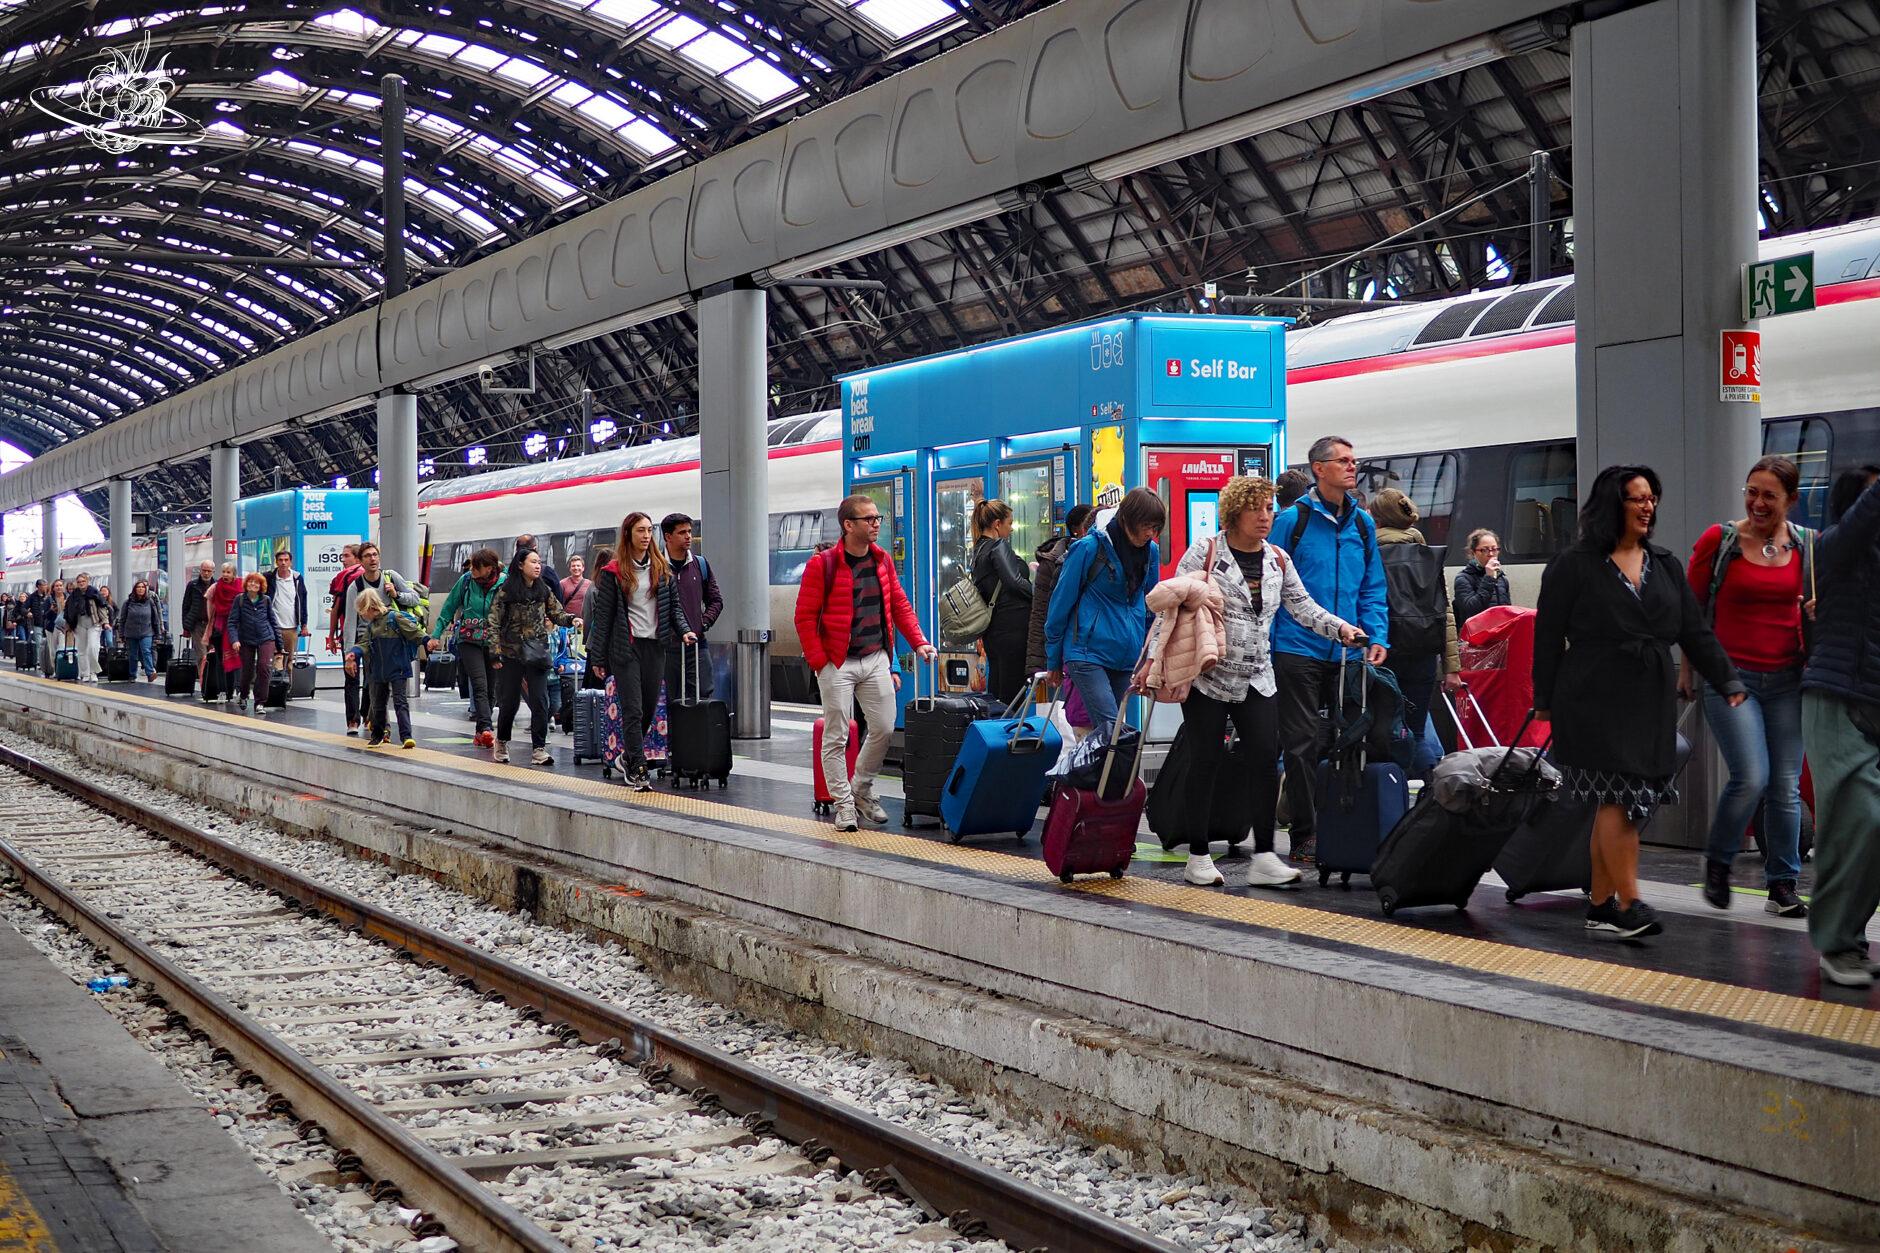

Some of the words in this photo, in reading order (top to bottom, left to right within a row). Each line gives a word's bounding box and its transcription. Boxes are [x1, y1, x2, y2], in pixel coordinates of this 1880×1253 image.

[1190, 358, 1224, 378] Self
[1227, 360, 1258, 380] Bar
[851, 379, 869, 397] your
[851, 398, 868, 416] best
[851, 416, 874, 434] break
[1181, 460, 1225, 474] LAVAZZA
[302, 492, 327, 502] your
[302, 501, 325, 511] best
[303, 511, 333, 521] break
[303, 521, 328, 530] .com
